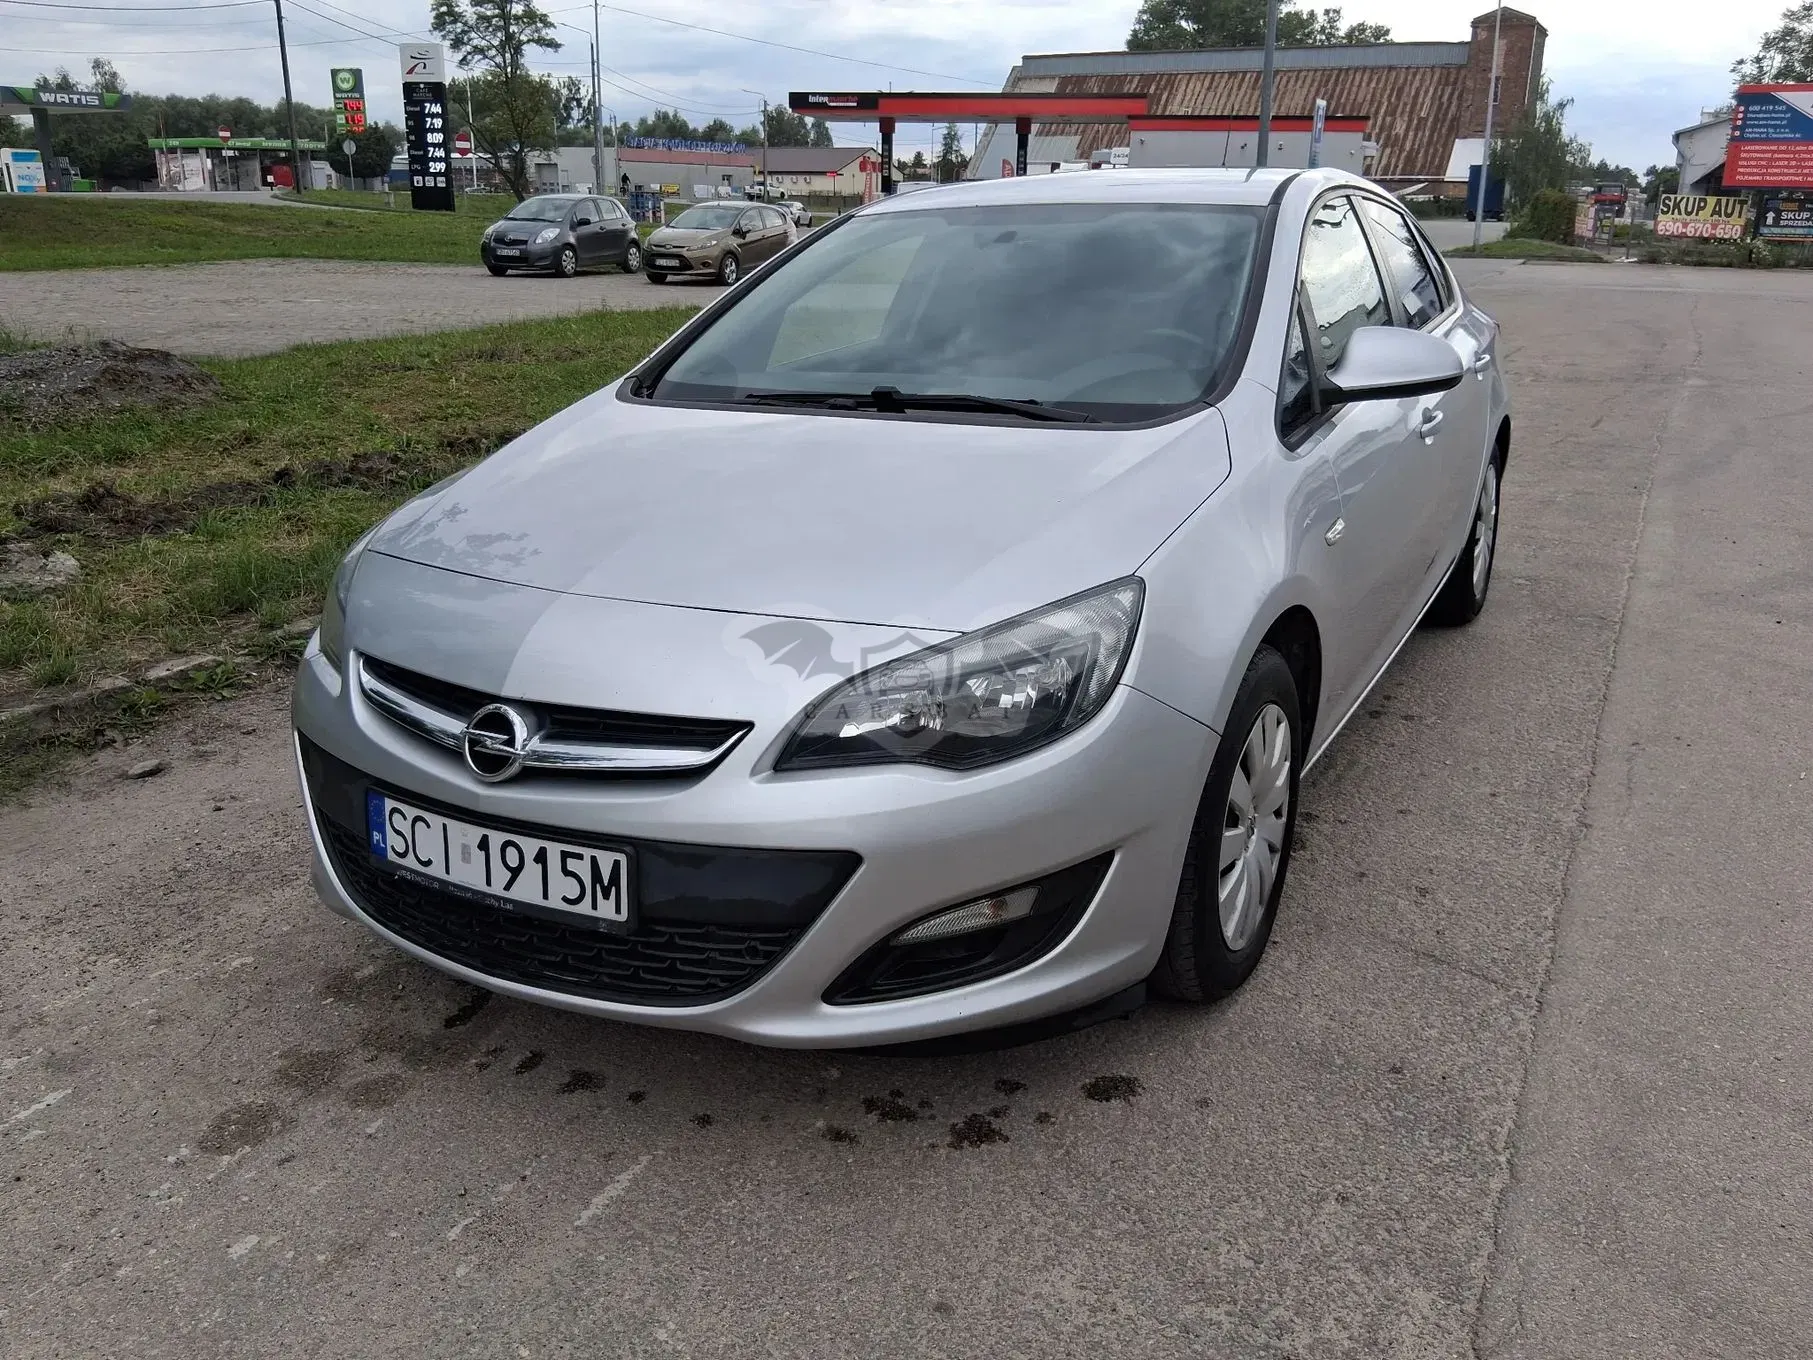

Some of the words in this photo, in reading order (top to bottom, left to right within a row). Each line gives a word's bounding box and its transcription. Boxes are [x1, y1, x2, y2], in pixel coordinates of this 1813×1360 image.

[39, 92, 99, 106] WATIS
[424, 103, 442, 114] 7.44
[425, 118, 443, 129] 7.19
[427, 132, 444, 143] 8.09
[427, 147, 446, 158] 7.44
[429, 161, 446, 173] 2.99
[1660, 195, 1708, 217] SKUP
[1710, 198, 1749, 219] AUT
[1780, 211, 1811, 220] SKUP
[1657, 222, 1742, 239] 690-670-650
[373, 831, 387, 848] PL
[388, 806, 451, 876] SCI
[476, 833, 622, 916] 1915M
